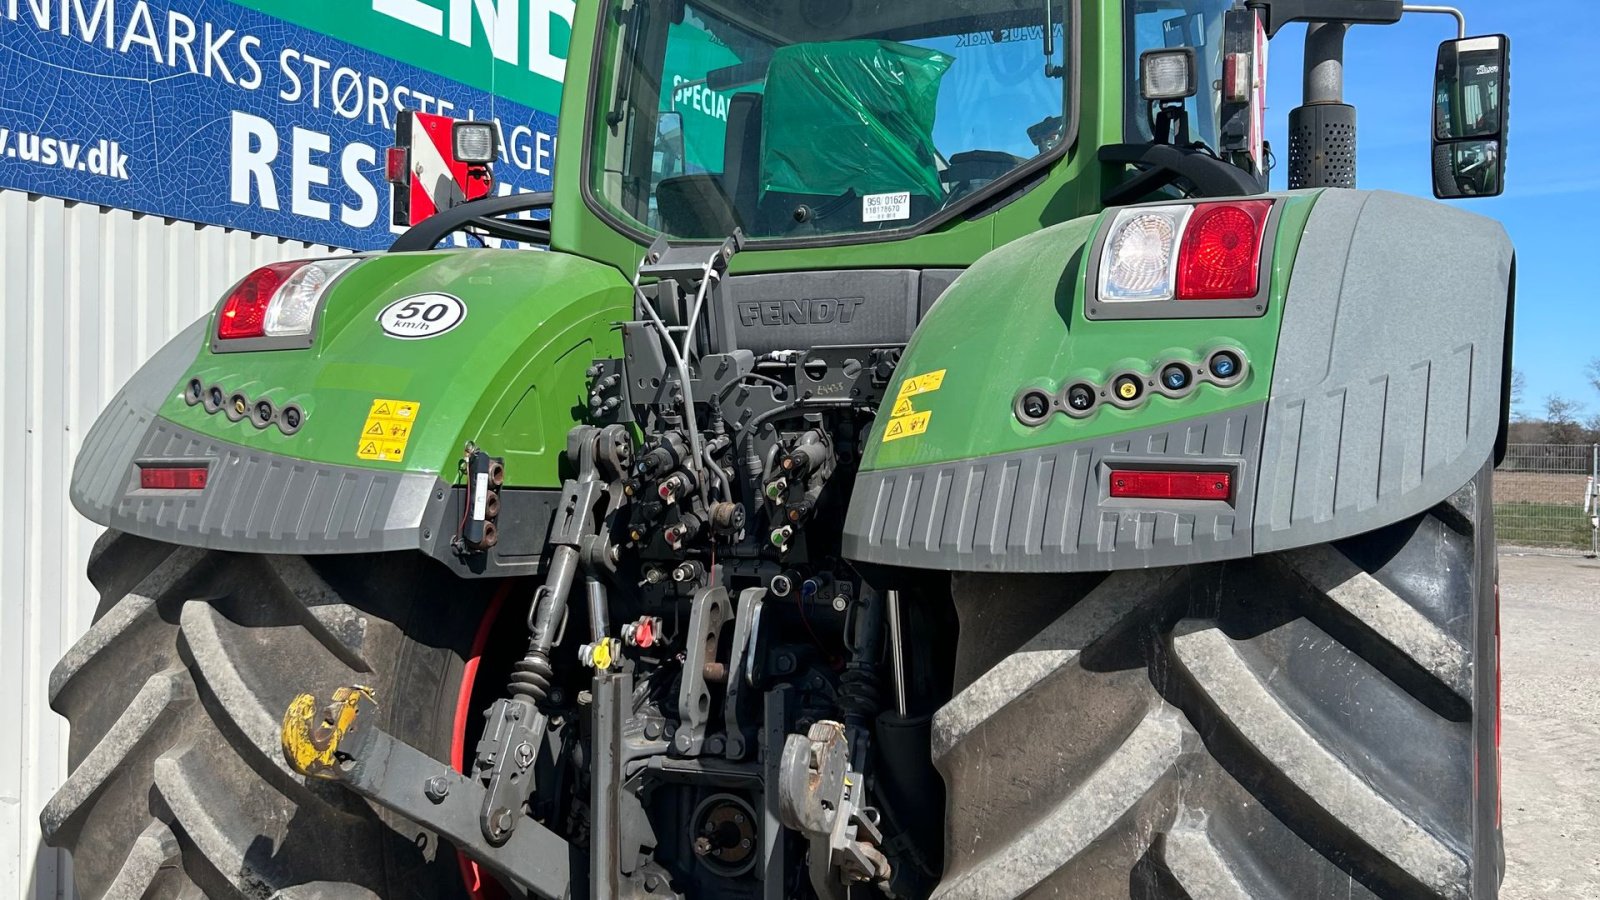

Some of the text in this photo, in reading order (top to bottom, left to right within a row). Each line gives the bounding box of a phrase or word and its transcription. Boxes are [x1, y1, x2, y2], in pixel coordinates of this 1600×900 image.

[673, 74, 731, 122] SPECIA
[396, 301, 449, 322] 50
[737, 297, 864, 326] FENDT
[393, 320, 430, 331] km/h
